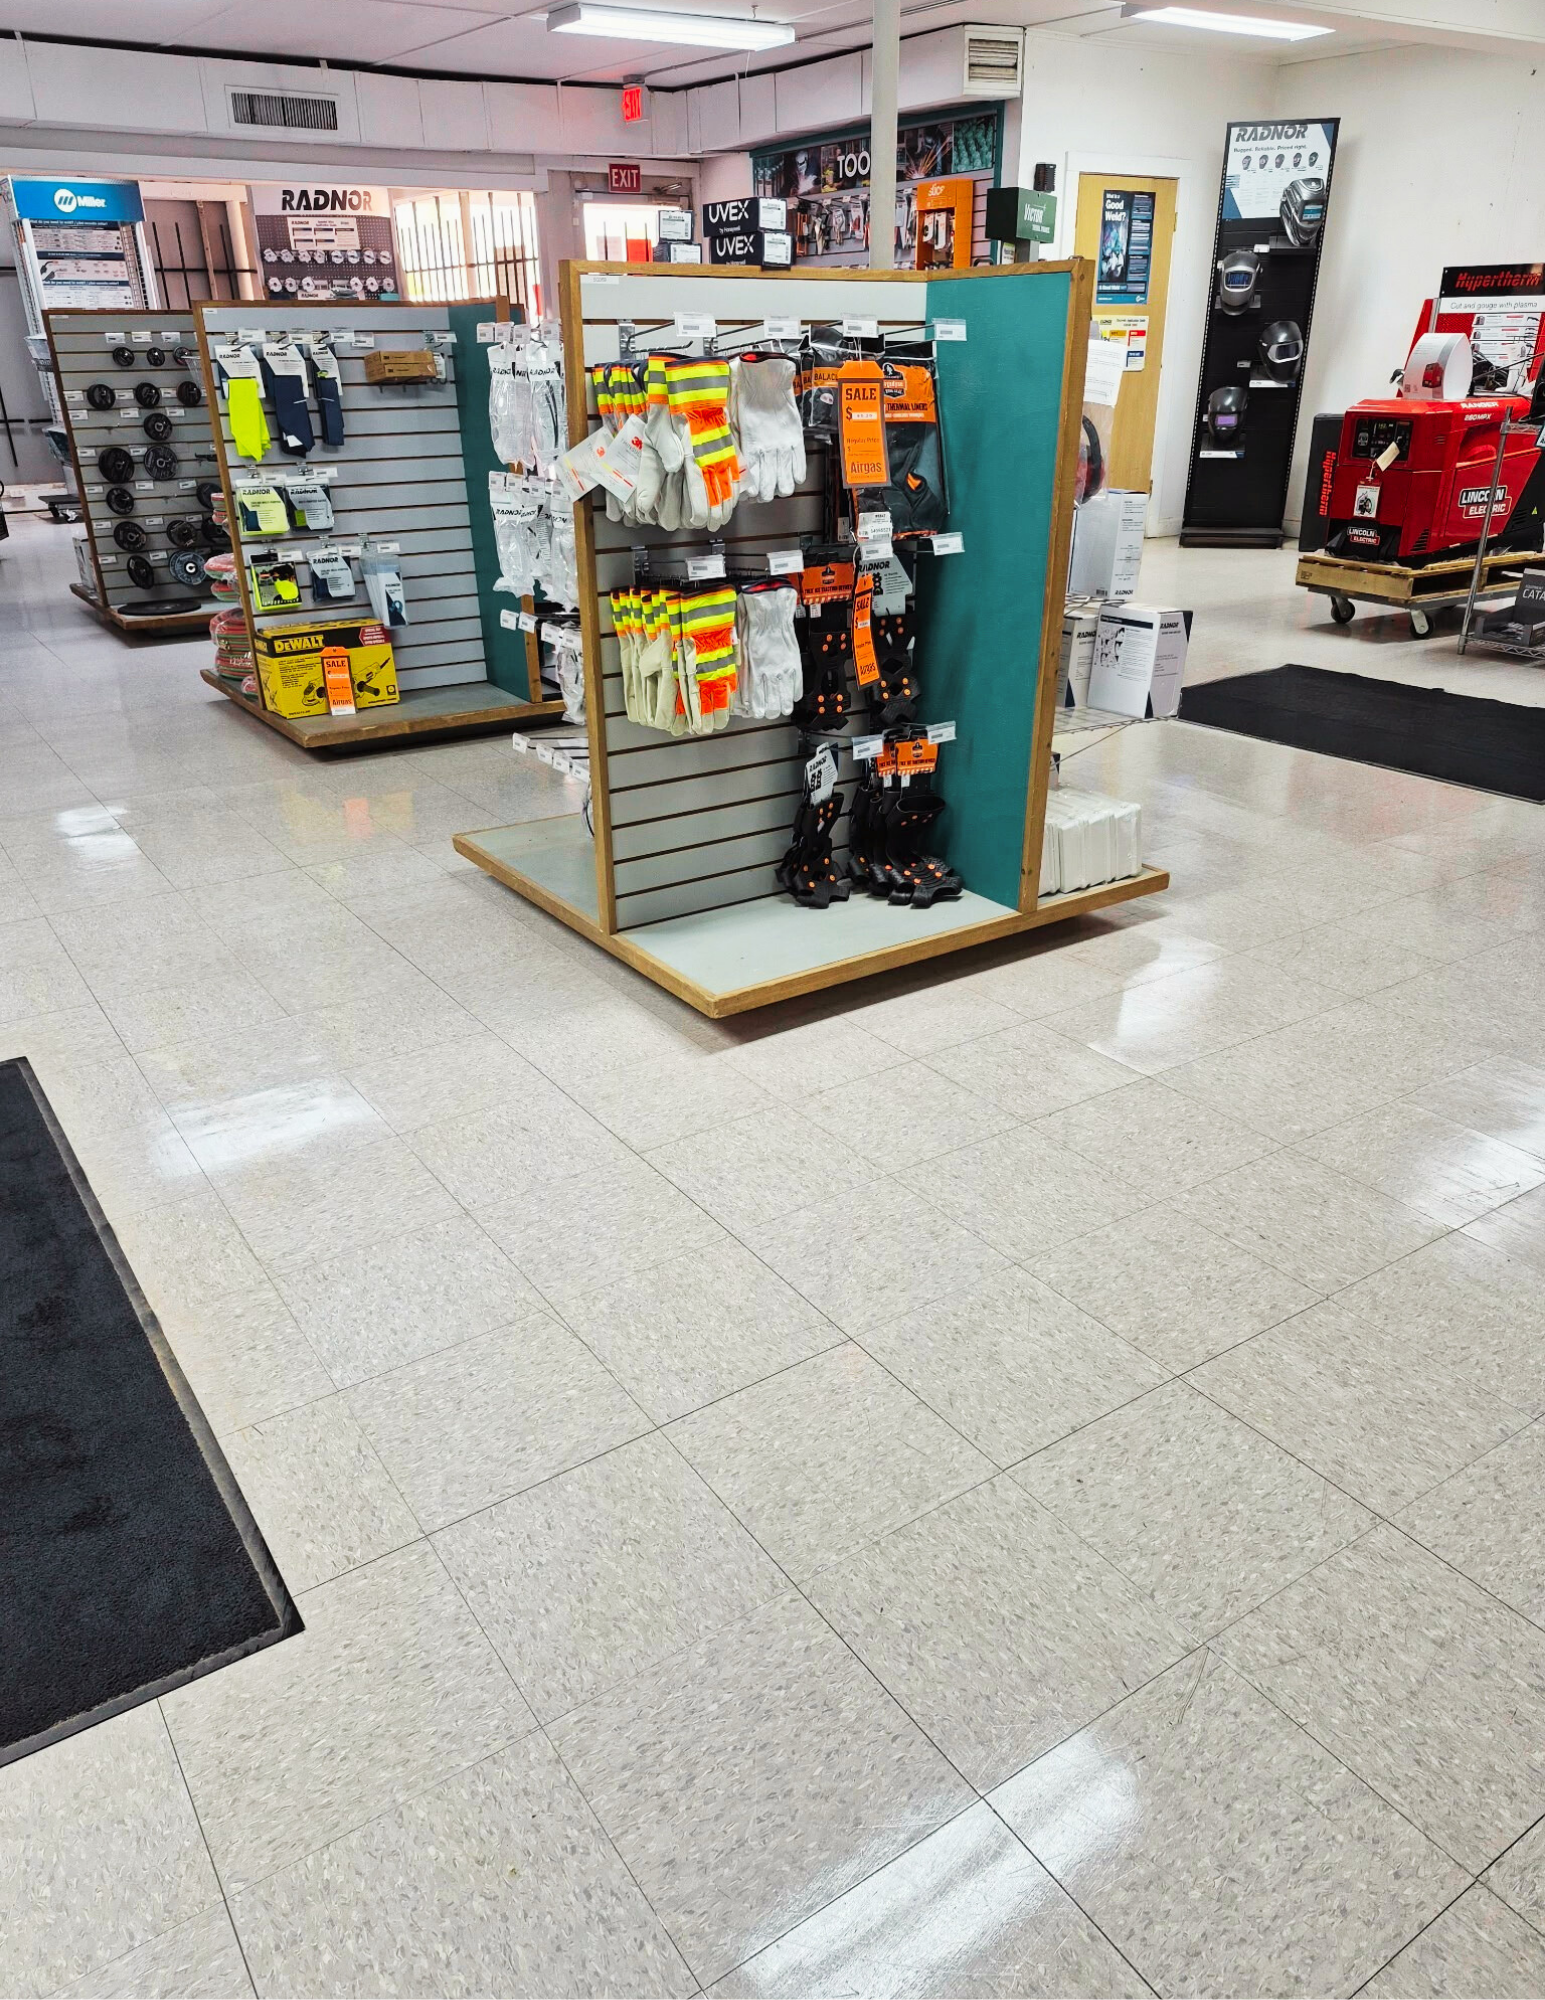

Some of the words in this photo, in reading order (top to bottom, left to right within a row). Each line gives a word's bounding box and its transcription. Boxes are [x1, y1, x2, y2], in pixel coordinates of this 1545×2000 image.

[1235, 125, 1309, 143] RADNOR
[611, 168, 639, 188] EXIT
[77, 195, 106, 208] Miller
[281, 189, 373, 211] RADNOR
[1105, 199, 1125, 209] Good
[708, 200, 751, 224] UVEX
[1105, 211, 1127, 221] Weld?
[716, 234, 755, 257] UVEX
[1455, 271, 1541, 291] Hypertherm
[1450, 302, 1462, 310] Cut
[1513, 301, 1538, 310] plasma
[845, 388, 877, 401] SALE
[1460, 401, 1499, 409] RANGER
[851, 461, 882, 475] Airgas
[1319, 451, 1336, 516] Hypertherm
[1461, 489, 1505, 504] LINCON
[1469, 503, 1506, 516] ELECRIC
[1348, 528, 1375, 537] LINCOLN
[1353, 535, 1377, 544] ELECTRIC
[312, 556, 339, 564] RADNOR
[858, 561, 890, 573] RADNOR
[856, 597, 869, 612] SALE
[326, 660, 346, 668] SALE
